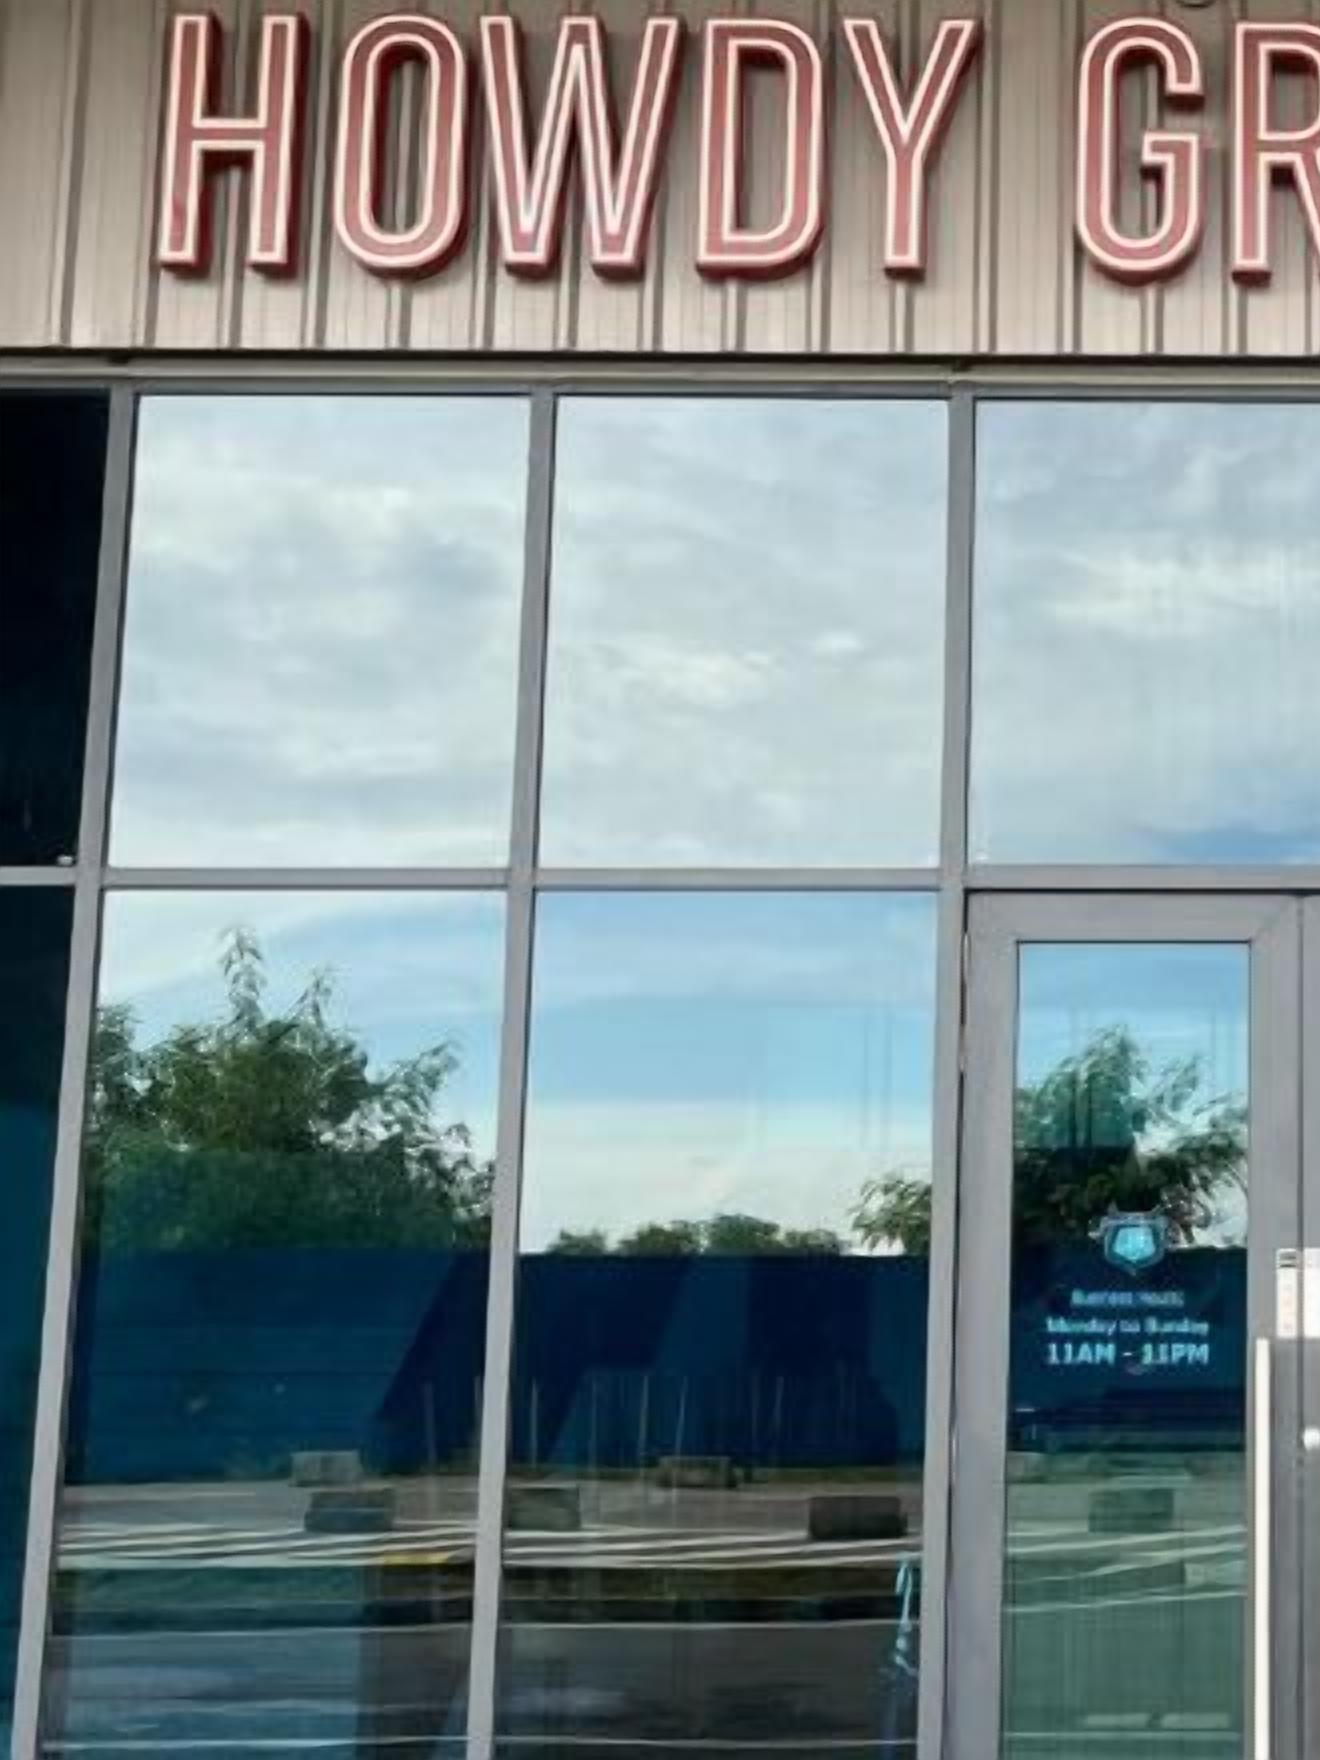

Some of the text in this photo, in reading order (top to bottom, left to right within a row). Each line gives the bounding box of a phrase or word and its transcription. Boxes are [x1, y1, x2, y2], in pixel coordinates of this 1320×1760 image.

[156, 13, 982, 276] HOWDY
[1047, 1342, 1117, 1366] 11AM
[1141, 1342, 1210, 1366] 11PM
